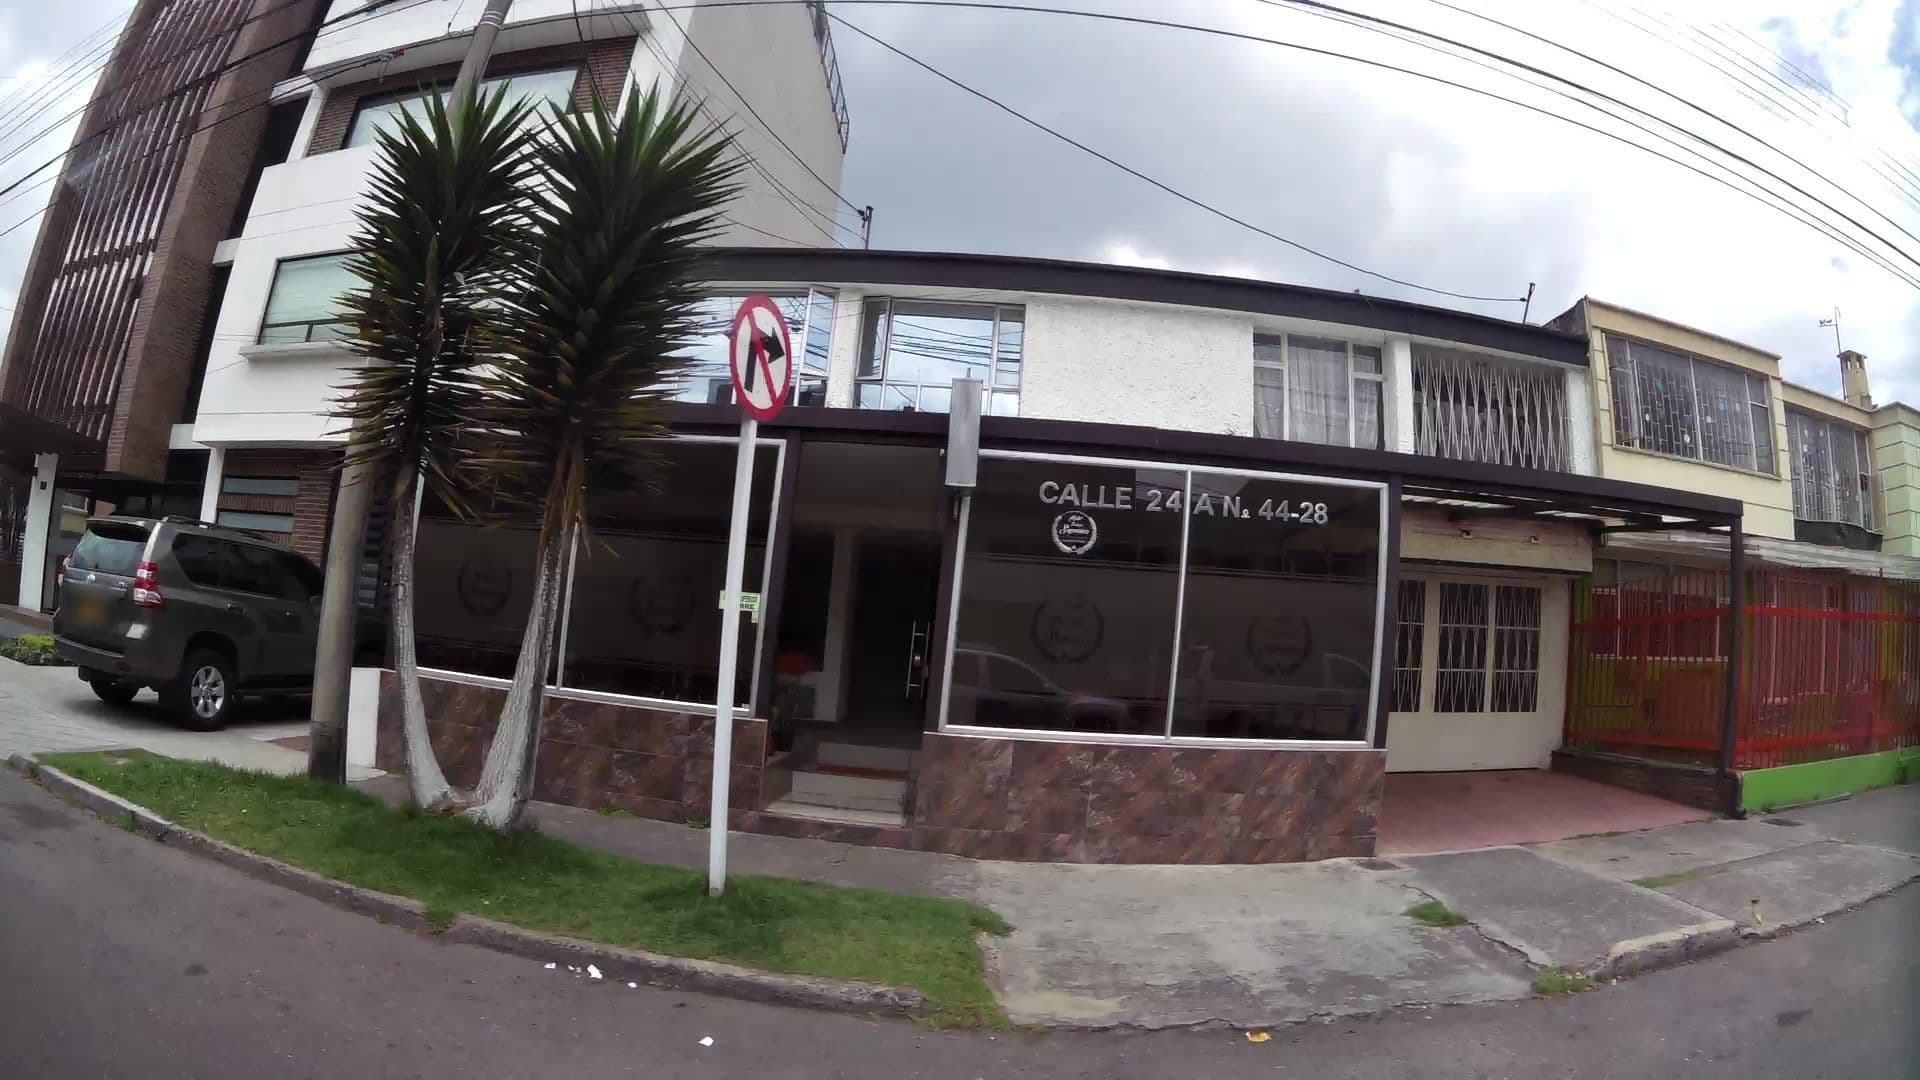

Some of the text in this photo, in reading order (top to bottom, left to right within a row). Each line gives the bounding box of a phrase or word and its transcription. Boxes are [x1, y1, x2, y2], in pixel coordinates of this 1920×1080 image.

[1039, 481, 1132, 509] CALLE
[1146, 489, 1182, 512] 24
[1258, 498, 1328, 525] 44-28
